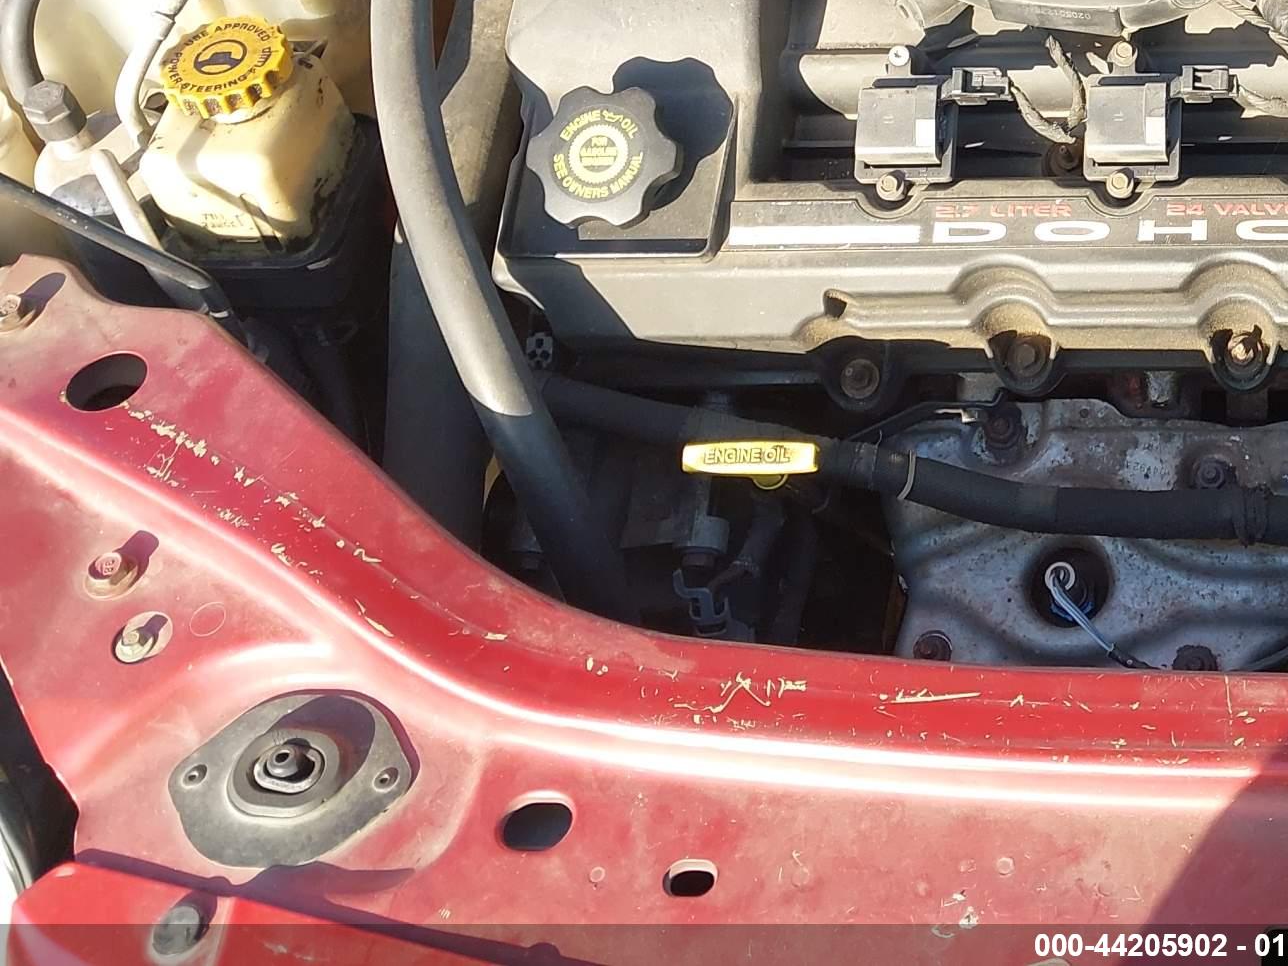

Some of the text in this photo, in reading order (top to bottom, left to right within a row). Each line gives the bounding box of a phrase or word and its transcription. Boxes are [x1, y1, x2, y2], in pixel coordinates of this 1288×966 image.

[185, 31, 209, 47] USE
[214, 22, 271, 42] APPROVED
[168, 52, 184, 84] POWER
[180, 76, 248, 93] STEERING
[560, 109, 639, 142] ENGINE OIL
[553, 153, 567, 179] SEE
[562, 177, 609, 199] OWNERS
[609, 151, 644, 194] MANUAL
[935, 203, 979, 218] 2.7
[990, 203, 1073, 218] LITER
[1166, 202, 1205, 217] 24
[703, 445, 790, 464] ENGINE OIL
